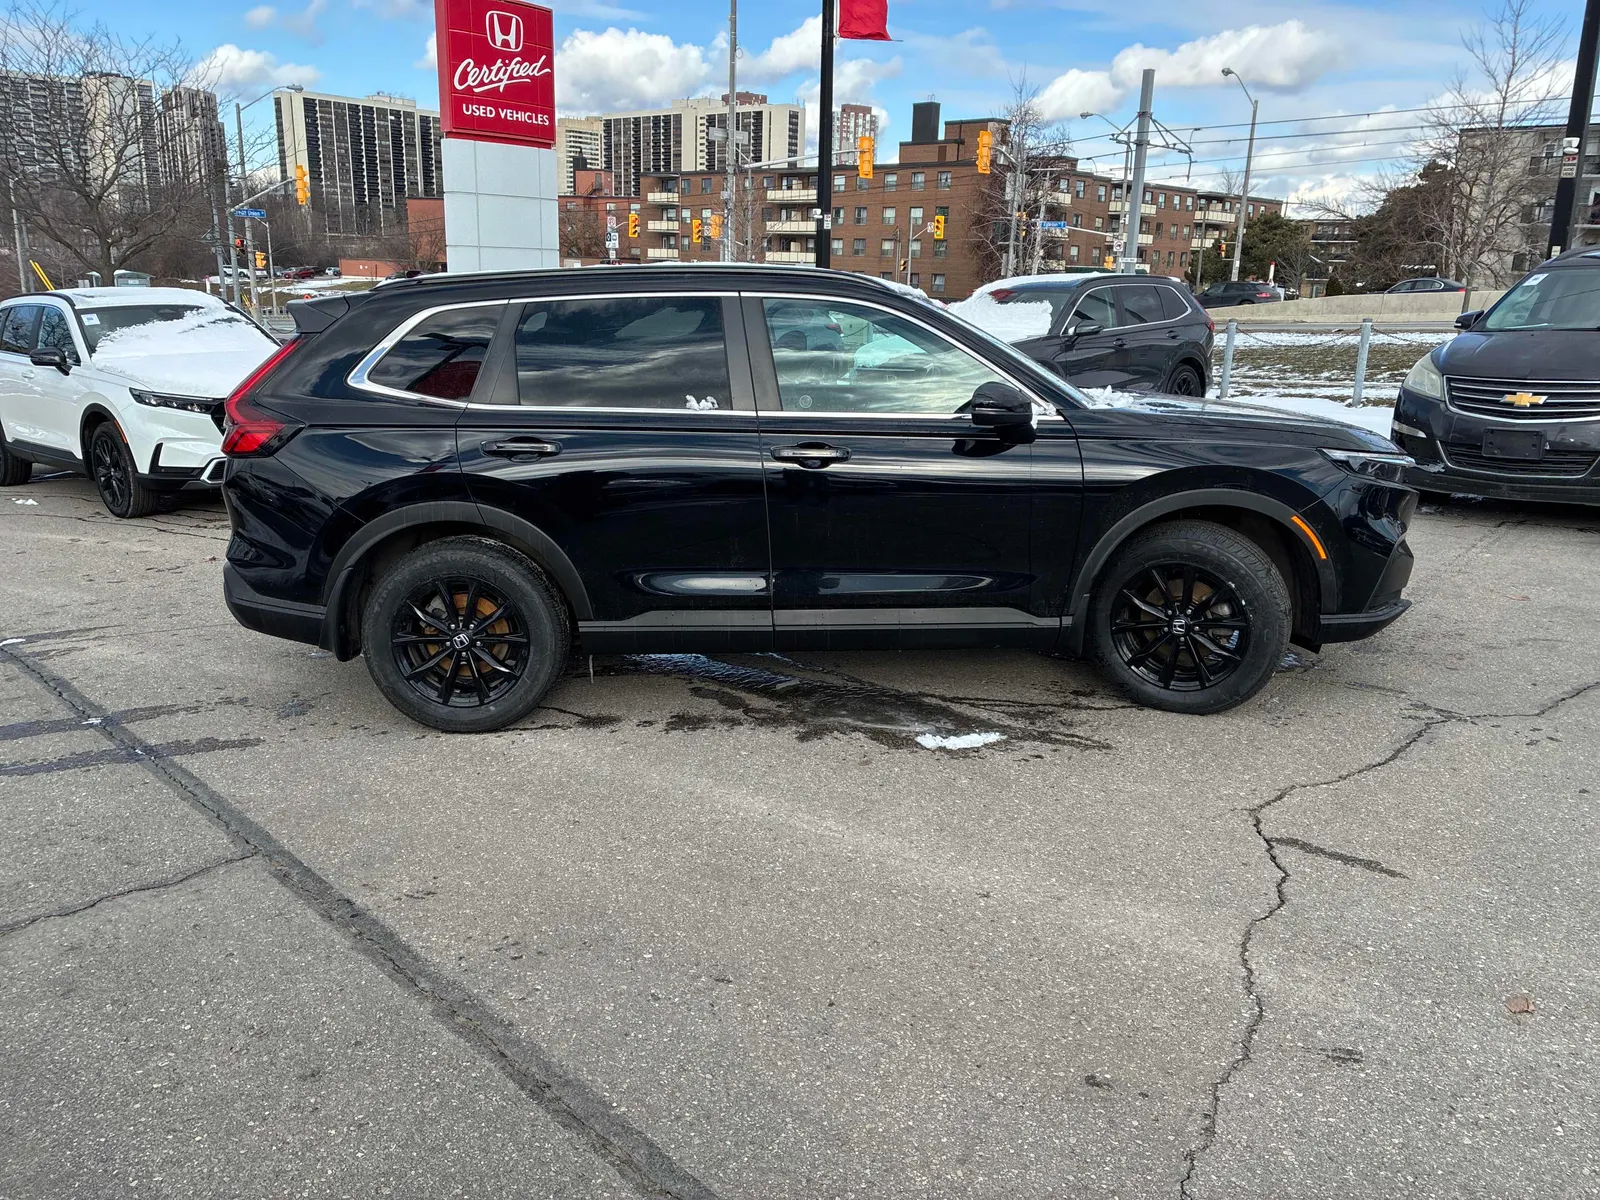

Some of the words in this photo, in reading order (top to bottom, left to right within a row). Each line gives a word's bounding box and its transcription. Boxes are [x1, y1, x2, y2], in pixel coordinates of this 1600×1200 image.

[454, 55, 551, 92] Certified
[462, 103, 496, 118] USED
[498, 107, 550, 126] VEHICLES
